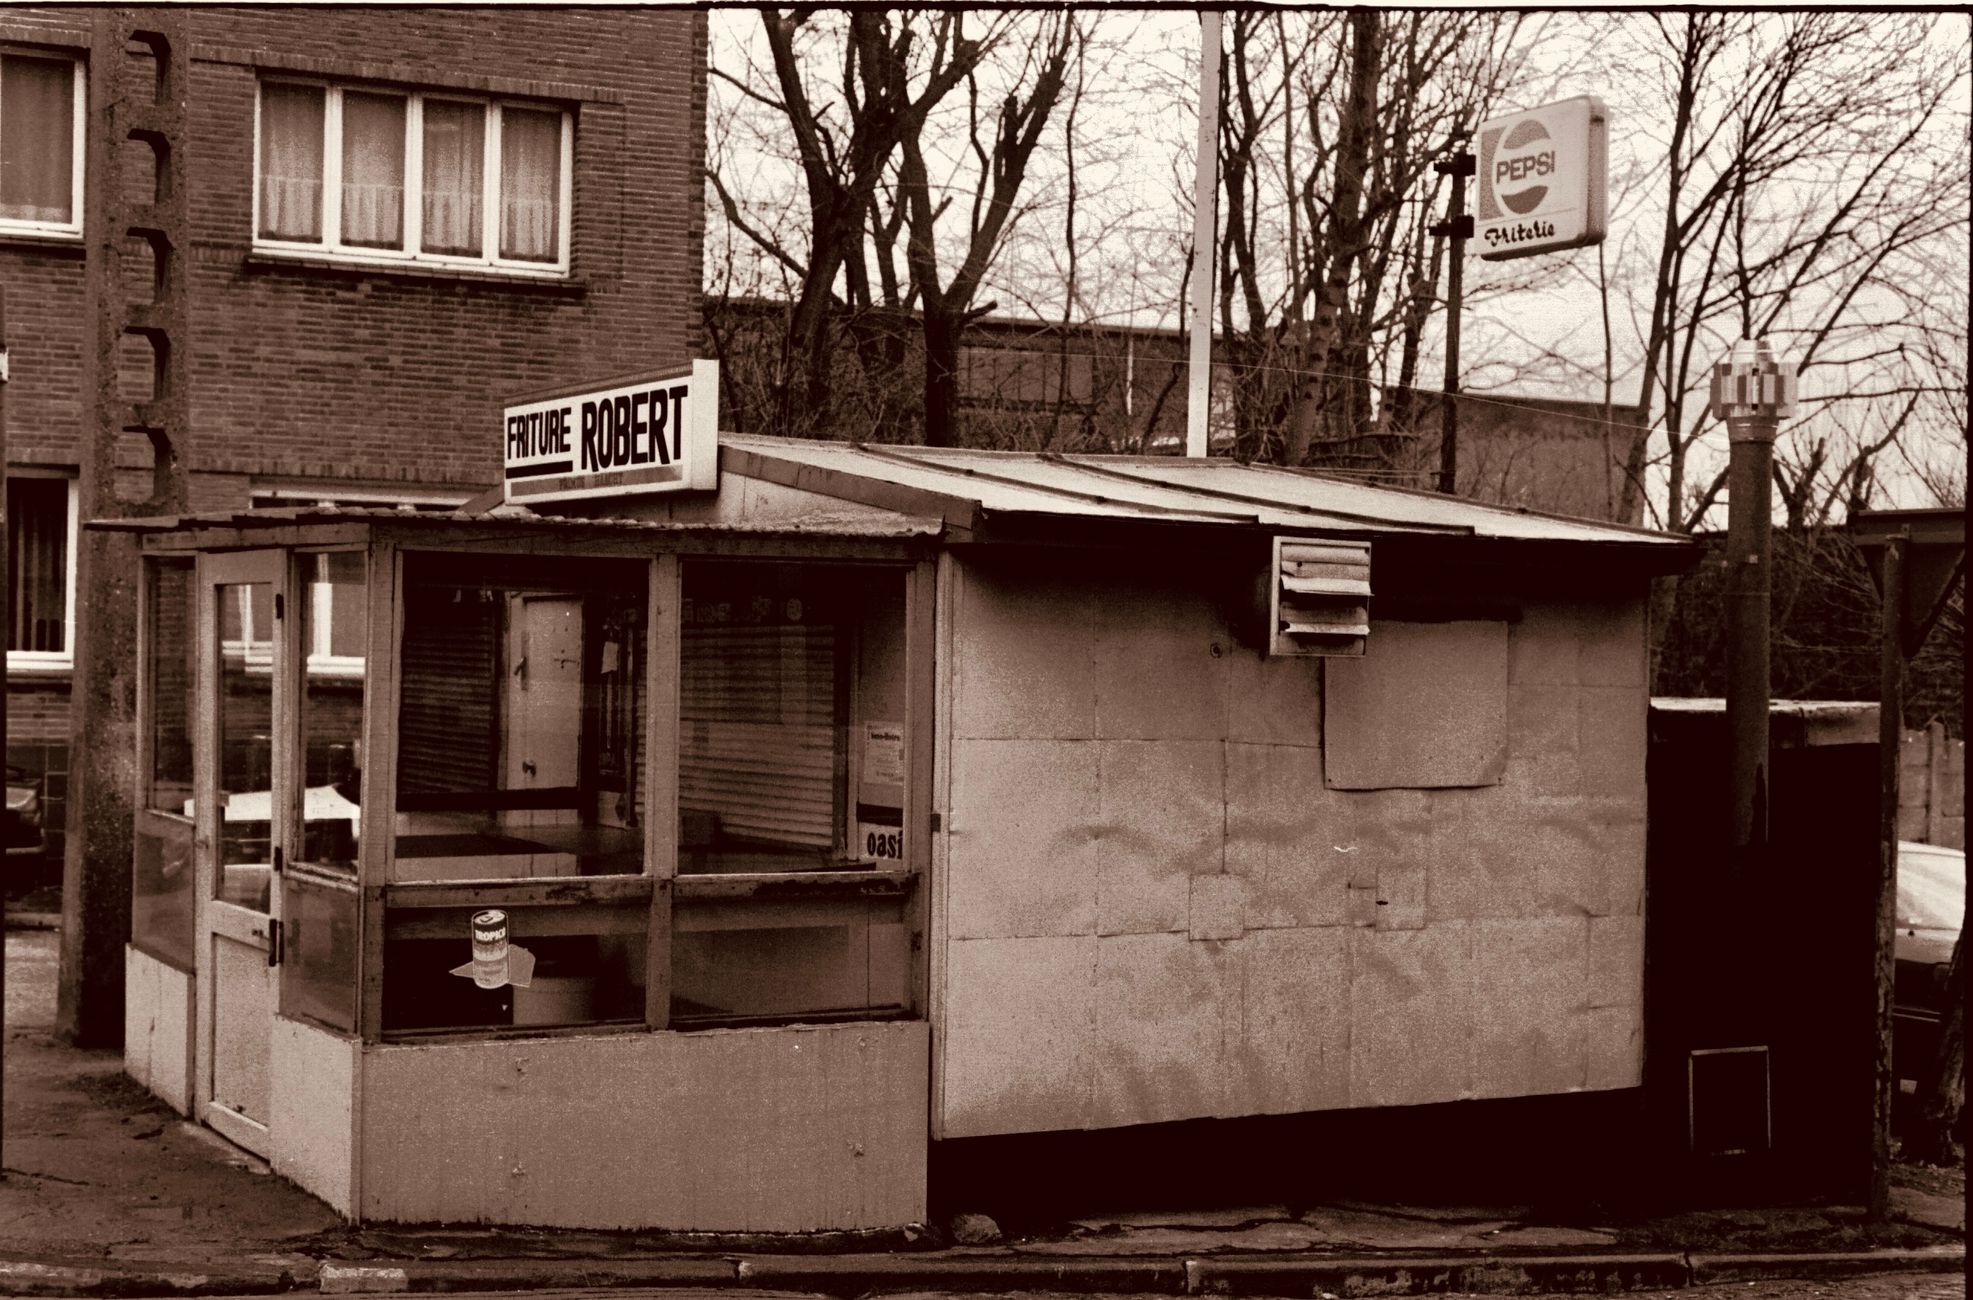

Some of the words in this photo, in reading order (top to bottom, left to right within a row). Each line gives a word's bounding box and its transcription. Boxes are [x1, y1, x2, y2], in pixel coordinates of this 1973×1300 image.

[1496, 151, 1555, 184] PEPSI
[1484, 220, 1556, 247] Friterie
[507, 406, 572, 460] FRITURE
[581, 385, 688, 472] ROBERT
